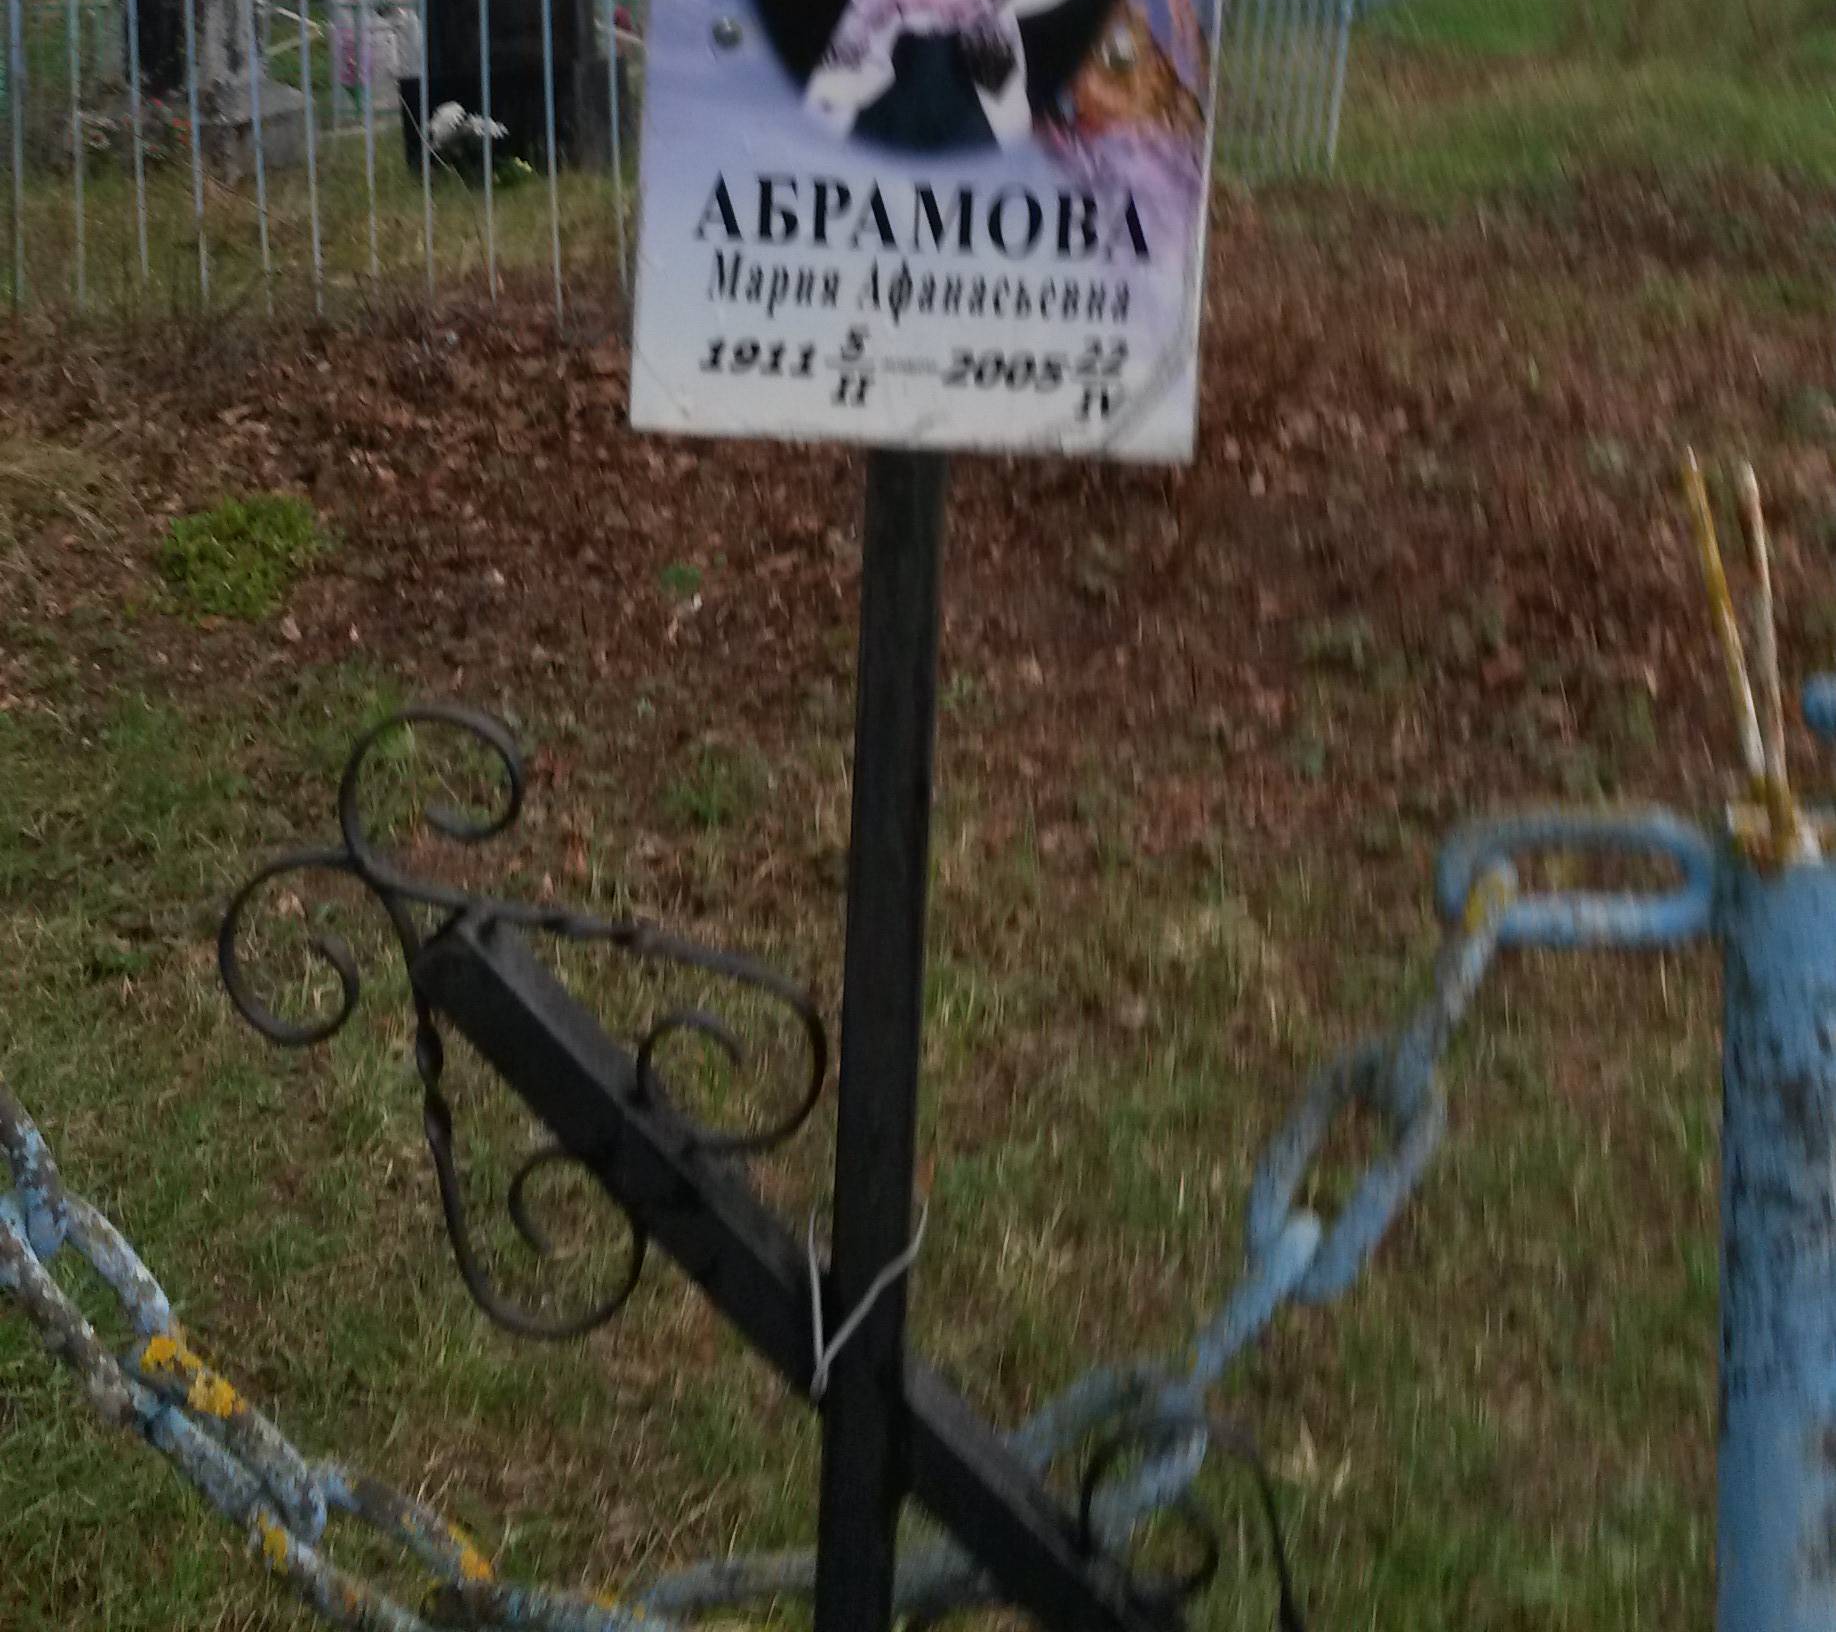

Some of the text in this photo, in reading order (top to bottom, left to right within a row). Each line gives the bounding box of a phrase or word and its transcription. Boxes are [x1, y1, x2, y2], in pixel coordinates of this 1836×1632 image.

[697, 171, 1151, 261] АБРАМОВА
[709, 249, 1130, 325] Мария Афанасьевна
[700, 338, 1067, 393] 1911 2005
